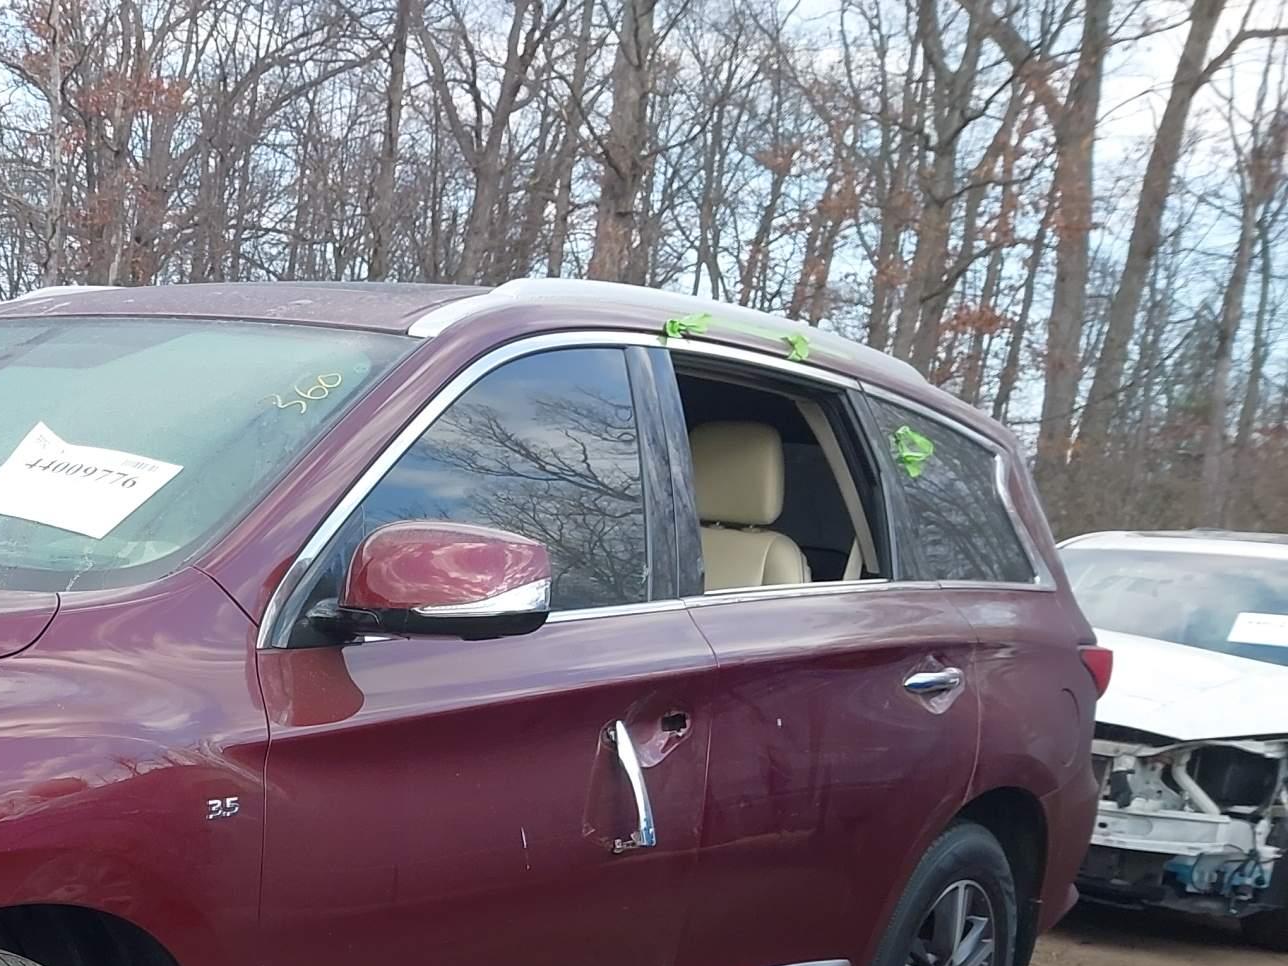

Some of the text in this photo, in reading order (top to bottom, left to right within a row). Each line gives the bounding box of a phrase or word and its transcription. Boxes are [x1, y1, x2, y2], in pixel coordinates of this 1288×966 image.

[263, 372, 342, 414] 360
[25, 457, 138, 489] 44009776
[206, 796, 240, 820] 3.5
